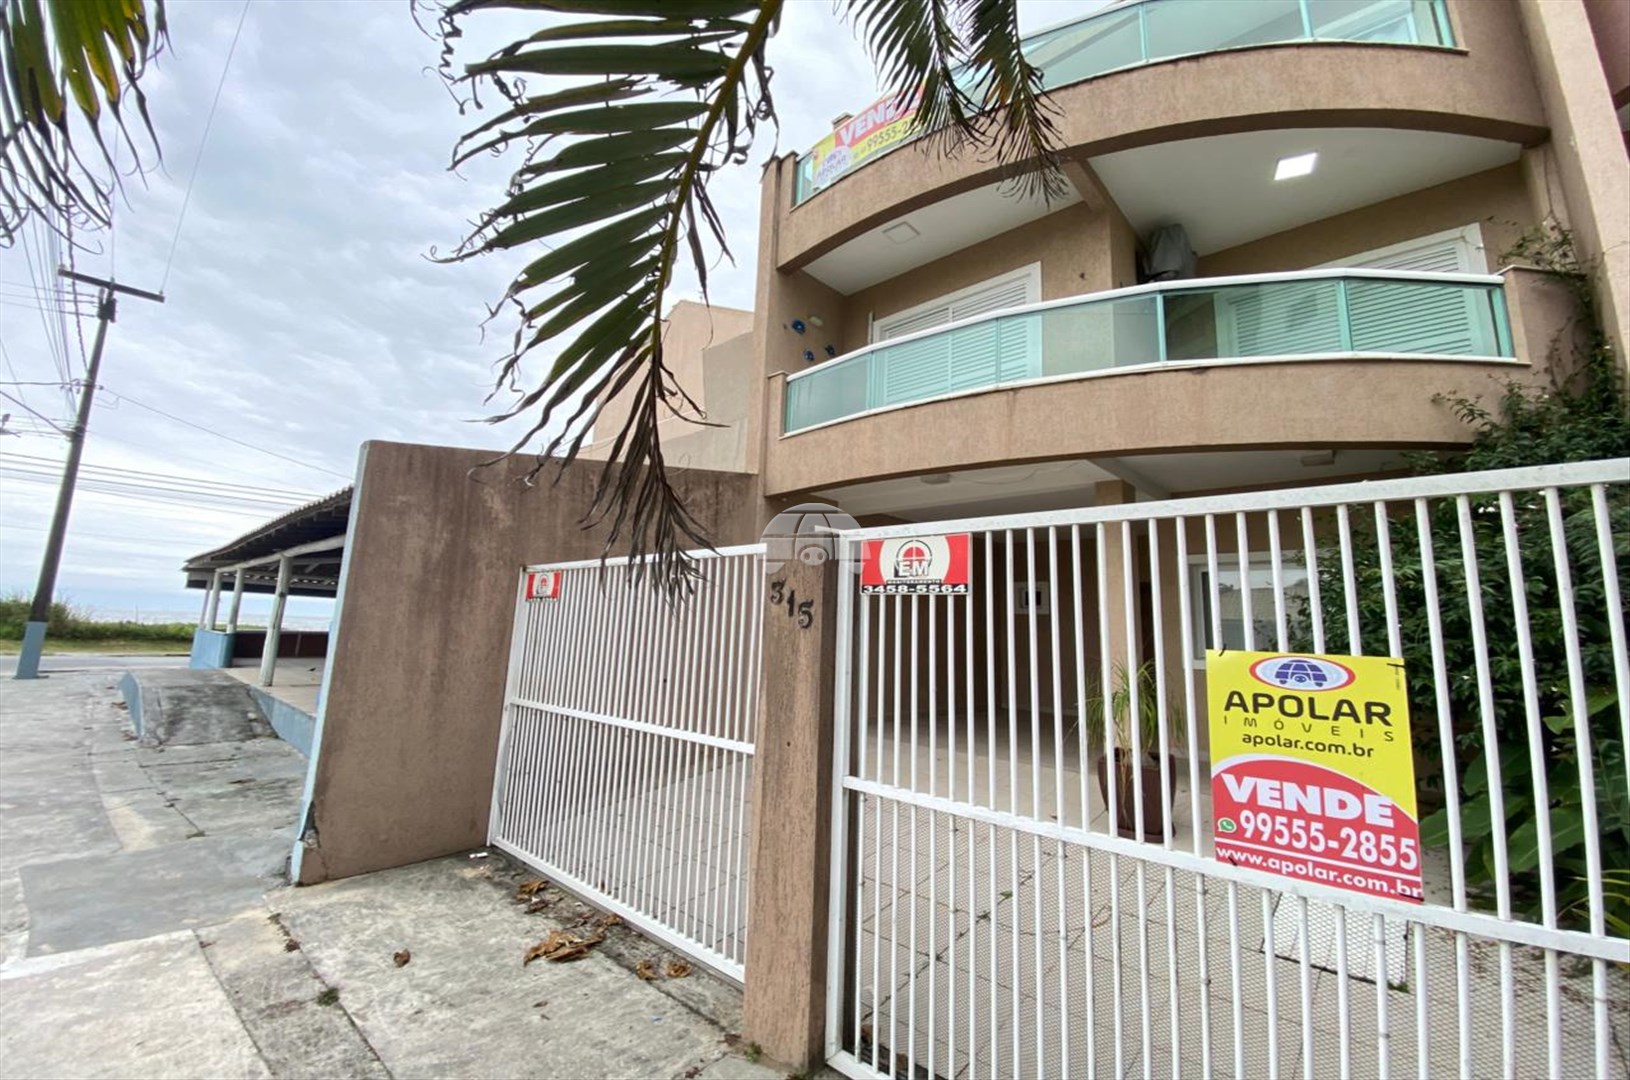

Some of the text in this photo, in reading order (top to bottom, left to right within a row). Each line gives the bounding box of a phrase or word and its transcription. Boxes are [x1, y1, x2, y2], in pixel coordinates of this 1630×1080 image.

[770, 577, 814, 630] 315
[862, 584, 968, 594] 3458-5564
[1223, 690, 1393, 728] APOLAR
[1223, 715, 1394, 743] IMÓVEIS
[1242, 732, 1375, 759] apolar.com.br
[1220, 772, 1395, 829] VENDE
[1239, 809, 1418, 871] 99555-2855
[1215, 846, 1423, 898] www.apolar.com.br
